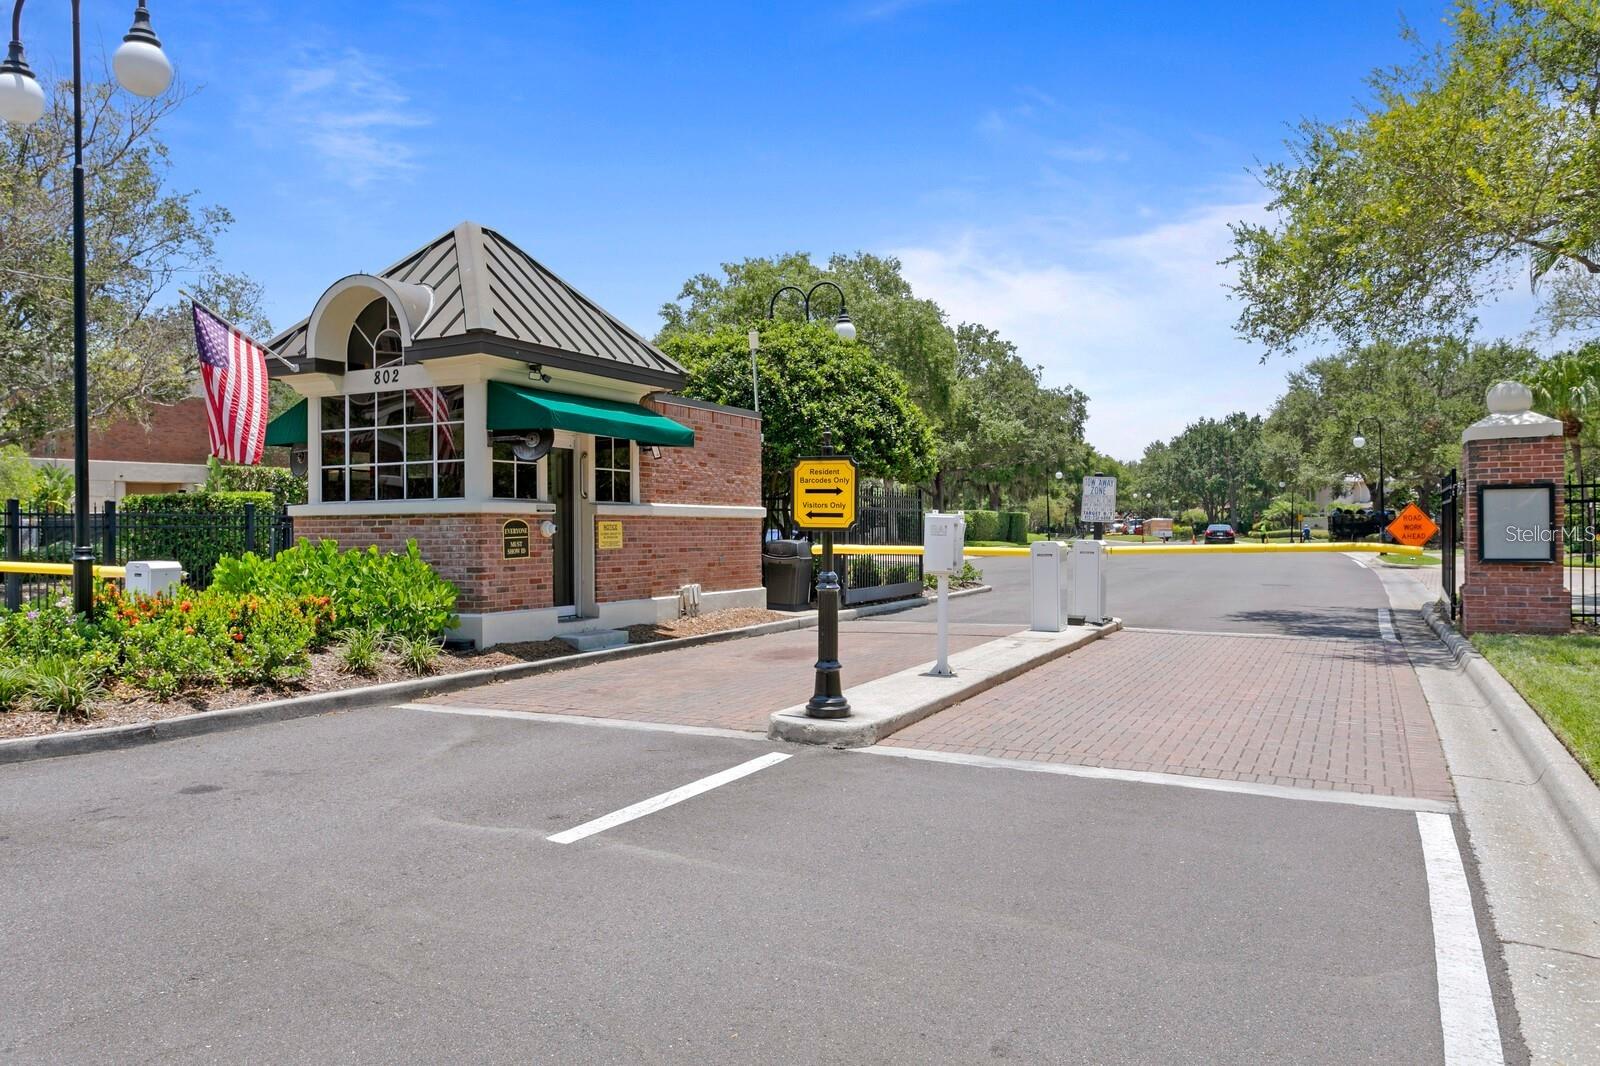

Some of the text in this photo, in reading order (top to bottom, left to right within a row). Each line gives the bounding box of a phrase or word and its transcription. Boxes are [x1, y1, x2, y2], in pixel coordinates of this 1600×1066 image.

[374, 369, 399, 385] 802
[833, 476, 850, 485] Only
[1098, 479, 1114, 487] AWAY
[1090, 486, 1106, 495] ZONE
[802, 501, 846, 510] Visitors Only
[1402, 514, 1423, 522] ROAD
[504, 527, 528, 535] EVERYONE
[1403, 523, 1423, 531] WORK
[1401, 532, 1426, 540] AHEAD
